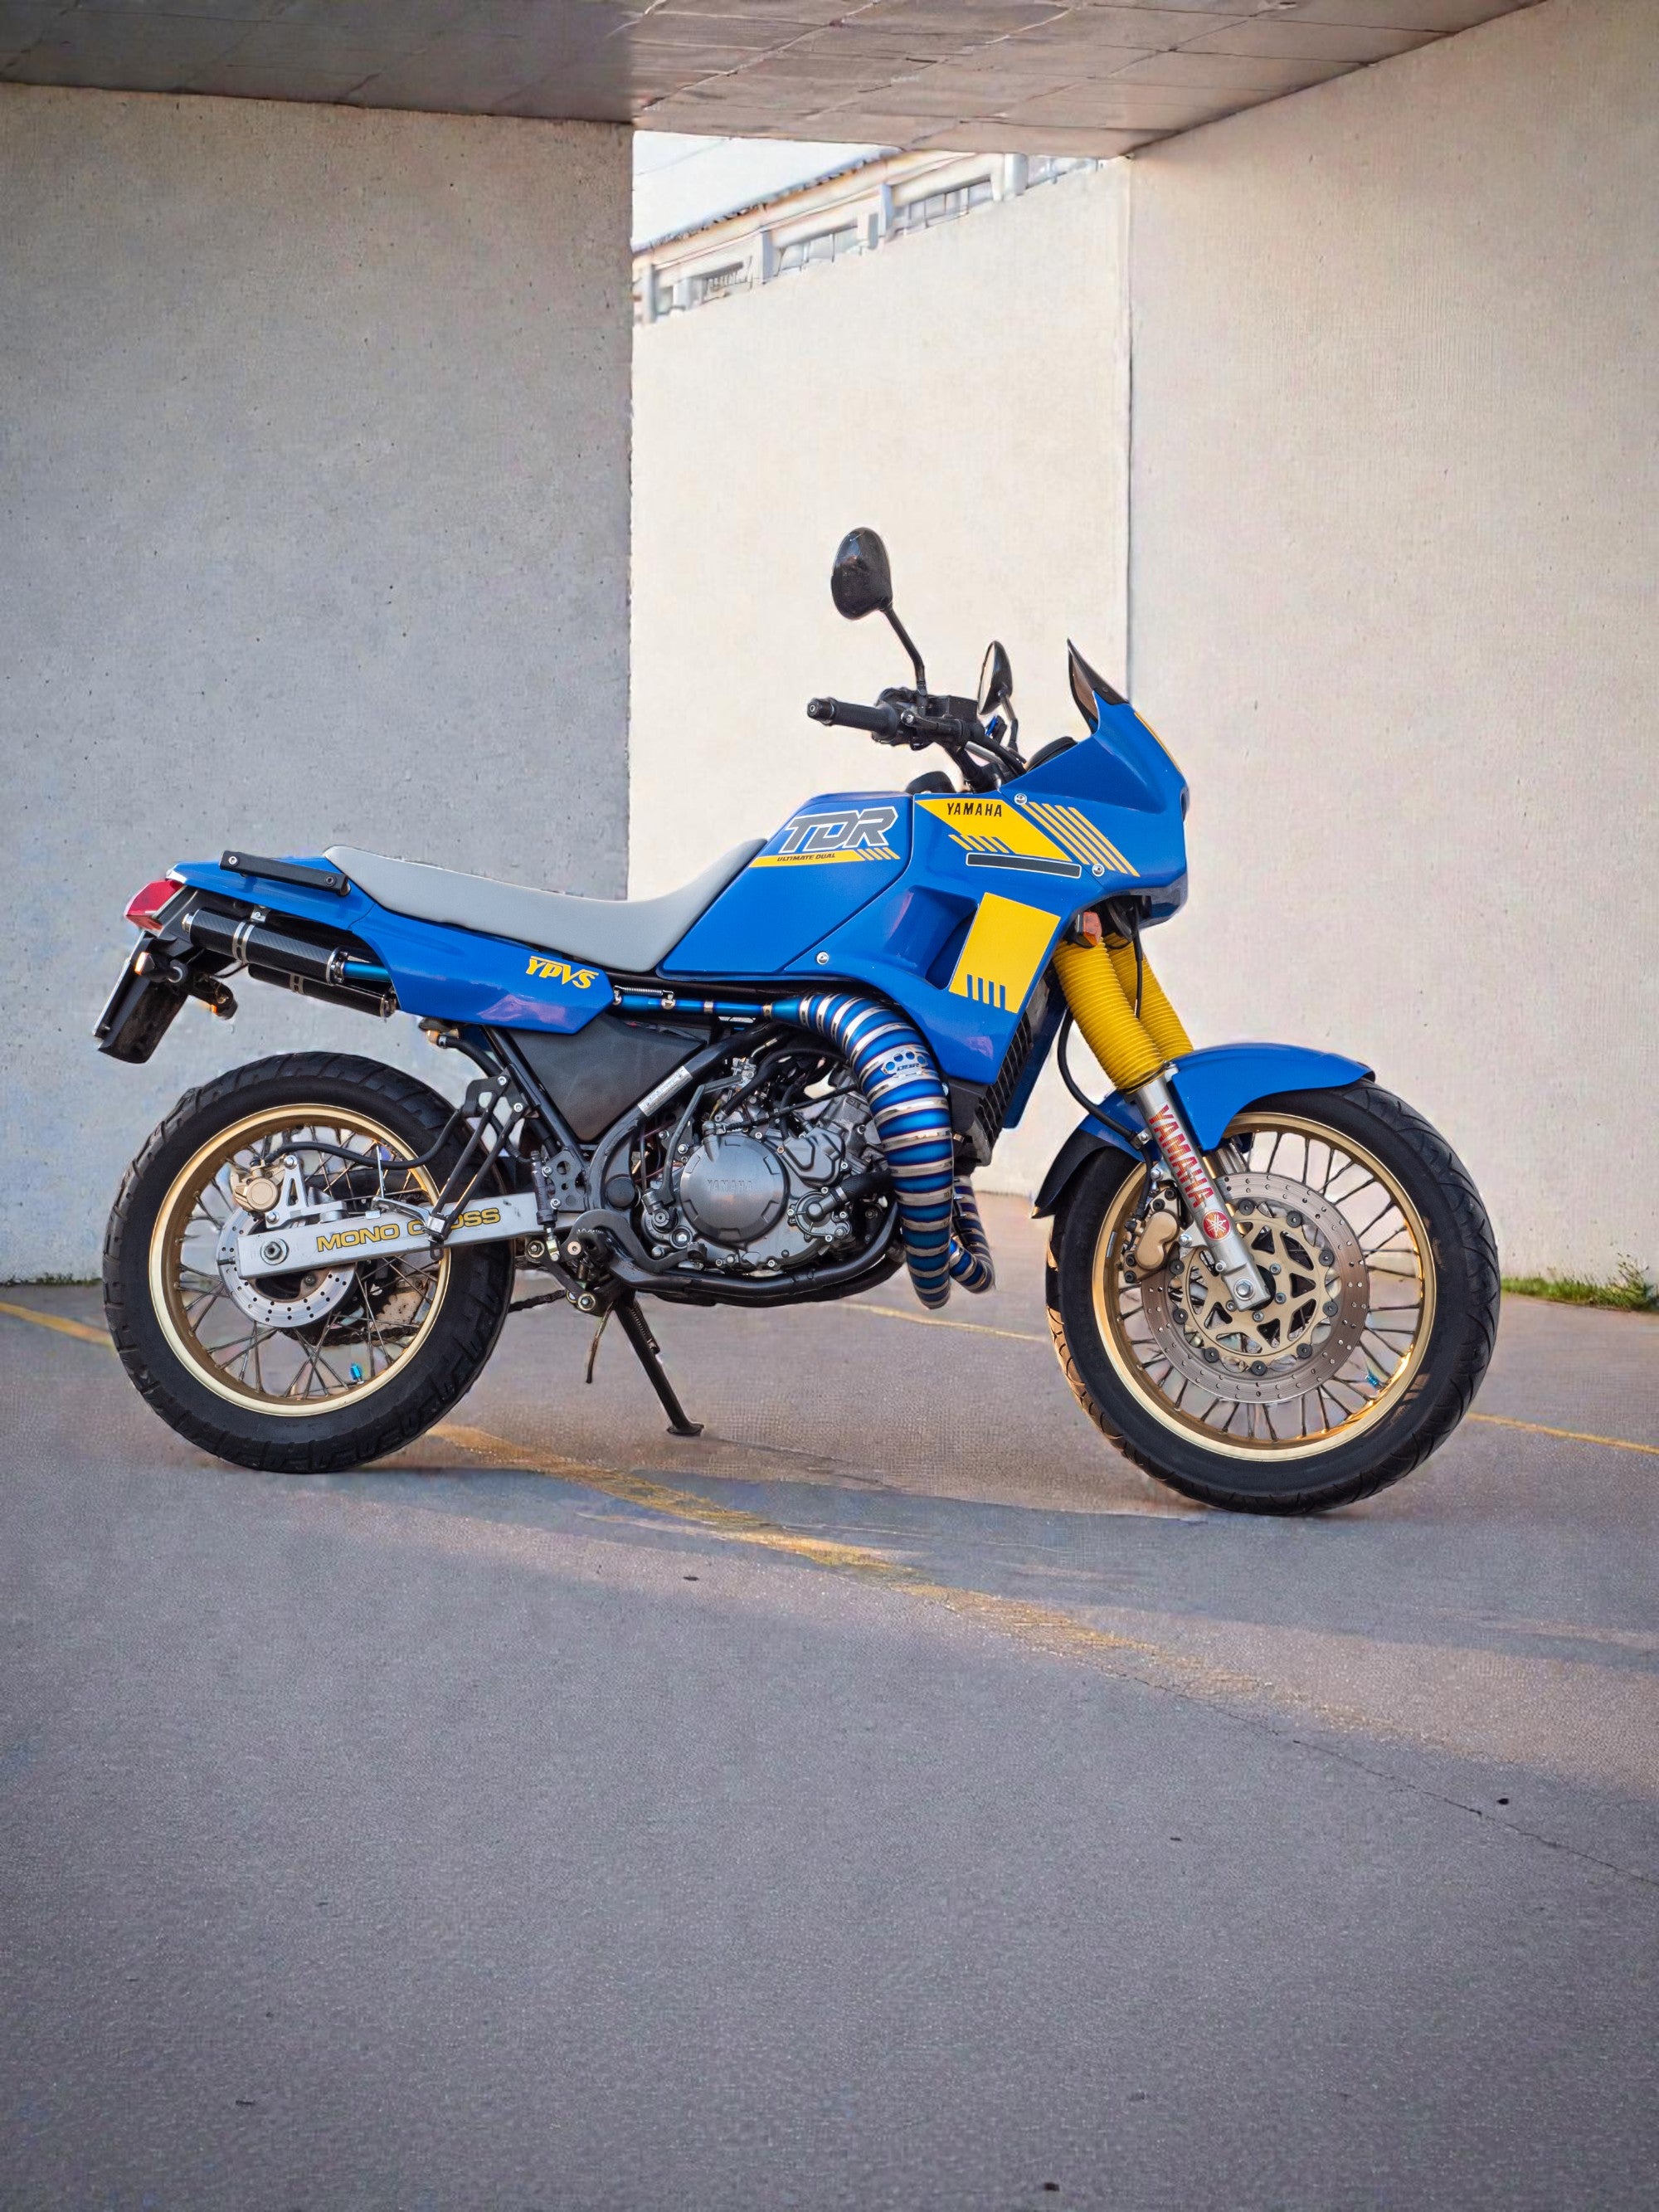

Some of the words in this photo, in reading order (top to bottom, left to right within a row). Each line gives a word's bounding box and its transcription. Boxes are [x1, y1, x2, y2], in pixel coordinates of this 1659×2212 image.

[947, 802, 1002, 817] YAMAHA
[778, 806, 898, 854] TDR
[525, 955, 599, 989] YPVS
[1149, 1104, 1214, 1208] YAMAHA
[707, 1179, 753, 1192] YAMAHA
[316, 1224, 400, 1252] MONO
